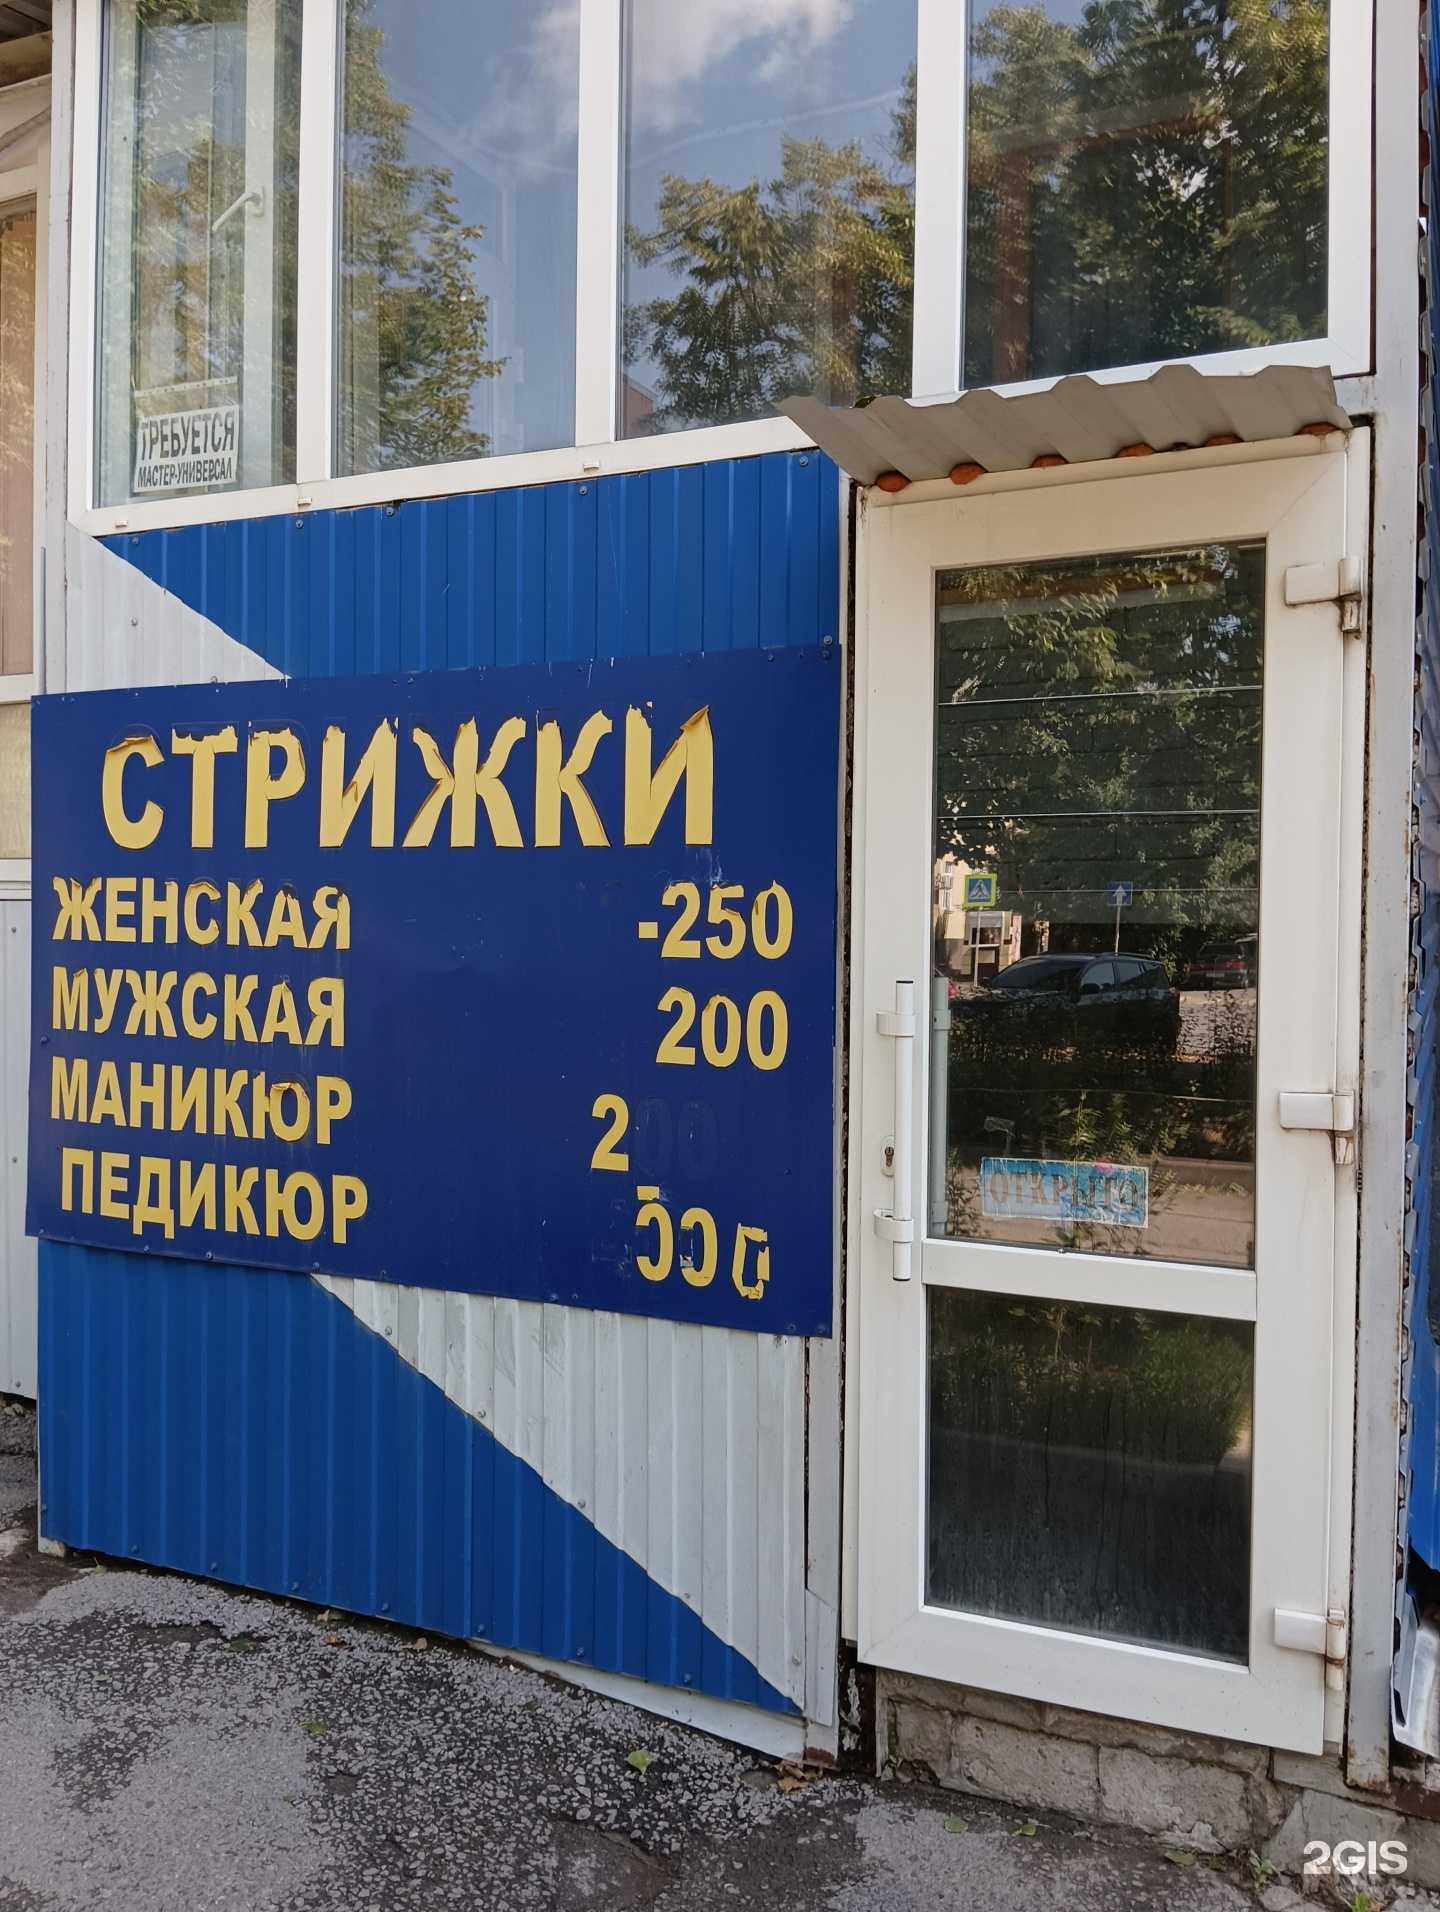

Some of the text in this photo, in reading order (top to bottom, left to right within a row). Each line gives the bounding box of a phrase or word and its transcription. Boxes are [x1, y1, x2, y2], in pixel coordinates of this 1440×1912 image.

[137, 457, 233, 488] МАСТЕР-УНИВЕРСАЛ
[139, 410, 236, 461] ТРЕБУЕТСЯ
[102, 706, 714, 849] СТРИЖКИ
[51, 876, 351, 950] ЖЕНСКАЯ
[51, 965, 789, 1071] МУЖСКАЯ 200
[50, 1055, 353, 1146] МАНИКЮР
[60, 1146, 369, 1245] ПЕДИКЮР
